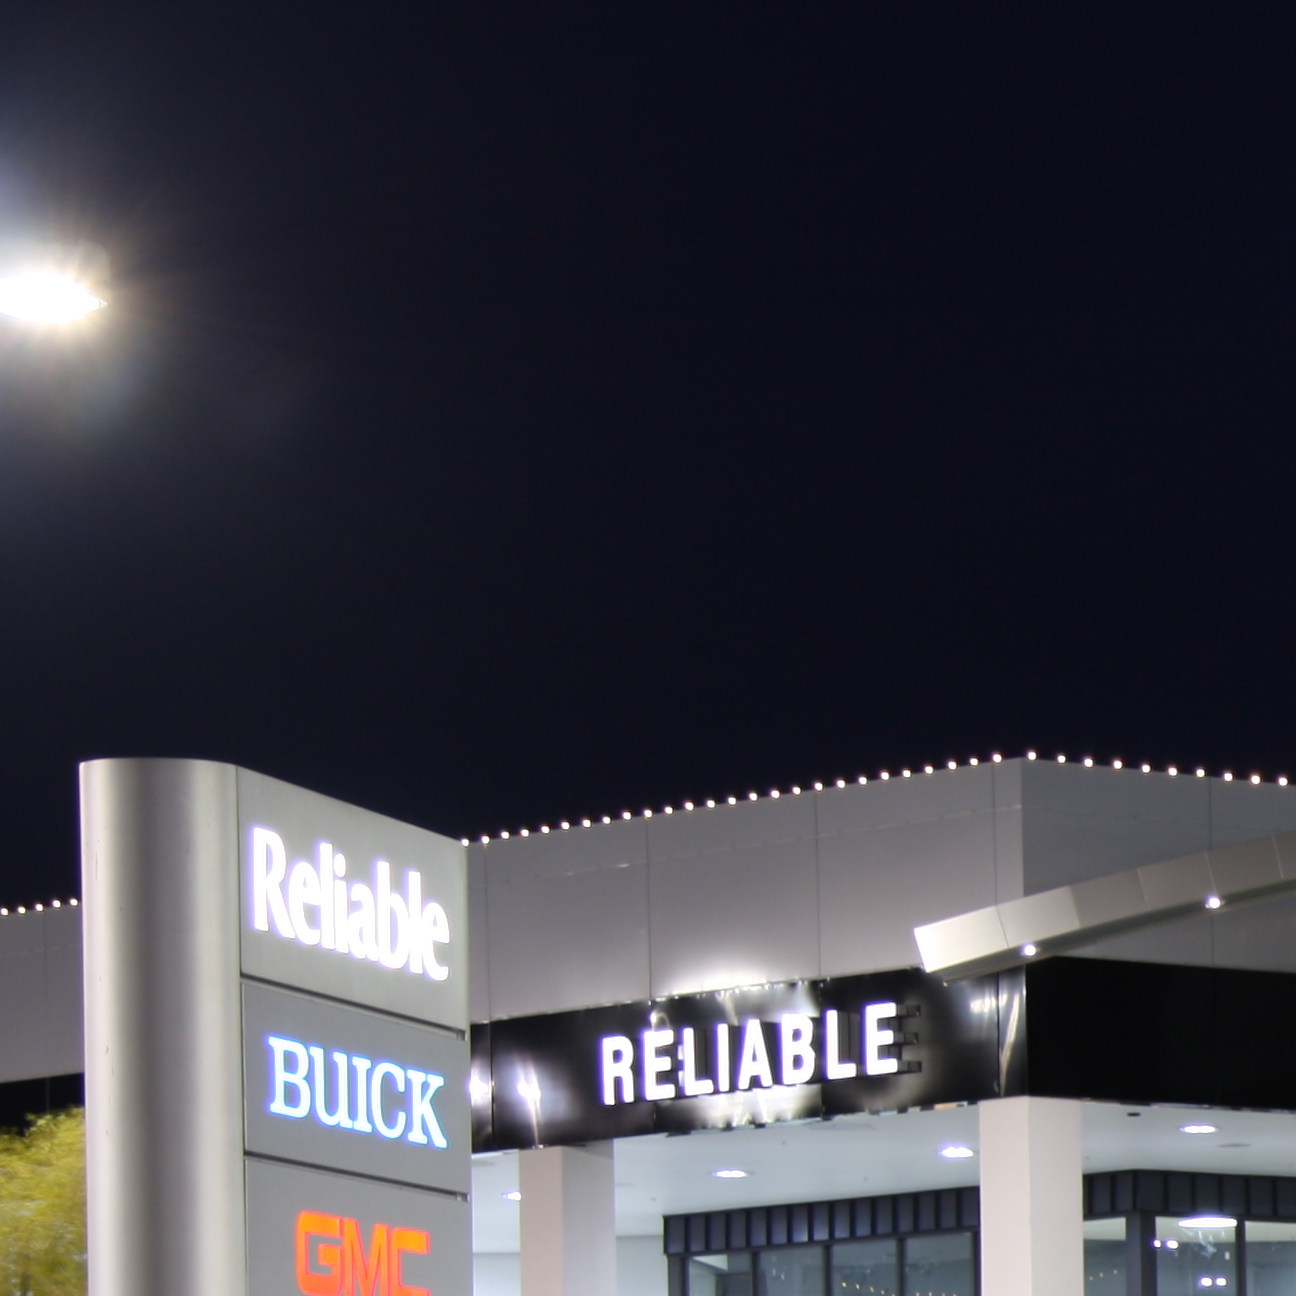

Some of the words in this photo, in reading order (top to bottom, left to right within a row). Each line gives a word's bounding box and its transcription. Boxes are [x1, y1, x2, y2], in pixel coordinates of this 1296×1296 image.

[252, 826, 450, 981] Reliable
[268, 1036, 448, 1149] BUICK
[601, 1002, 899, 1106] RELIABLE
